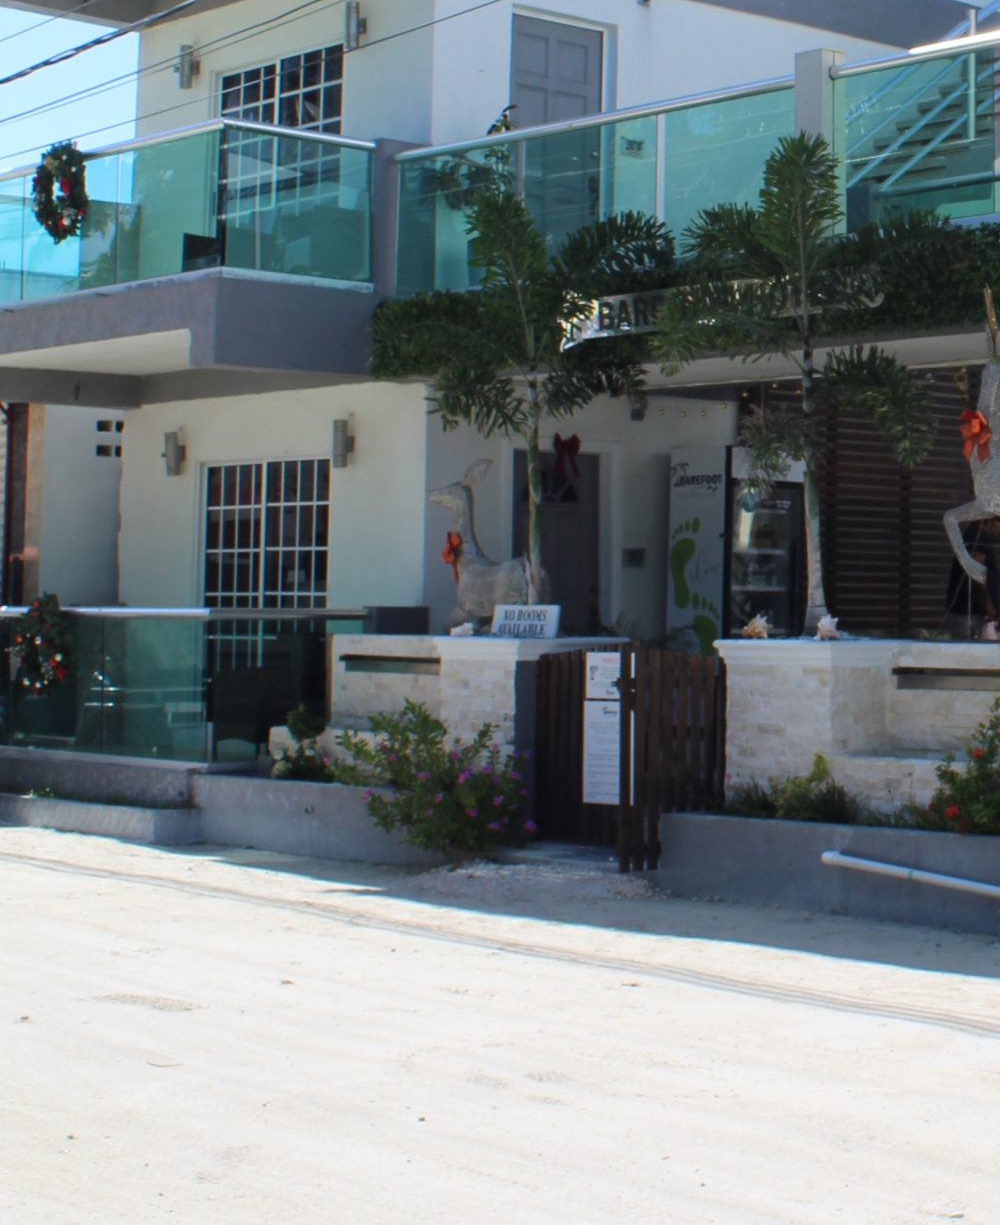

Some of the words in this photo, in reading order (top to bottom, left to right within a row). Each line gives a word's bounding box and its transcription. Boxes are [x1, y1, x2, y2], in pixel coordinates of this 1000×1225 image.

[504, 609, 515, 621] NO
[517, 609, 547, 622] ROOMS
[498, 623, 546, 635] AVAILABLE
